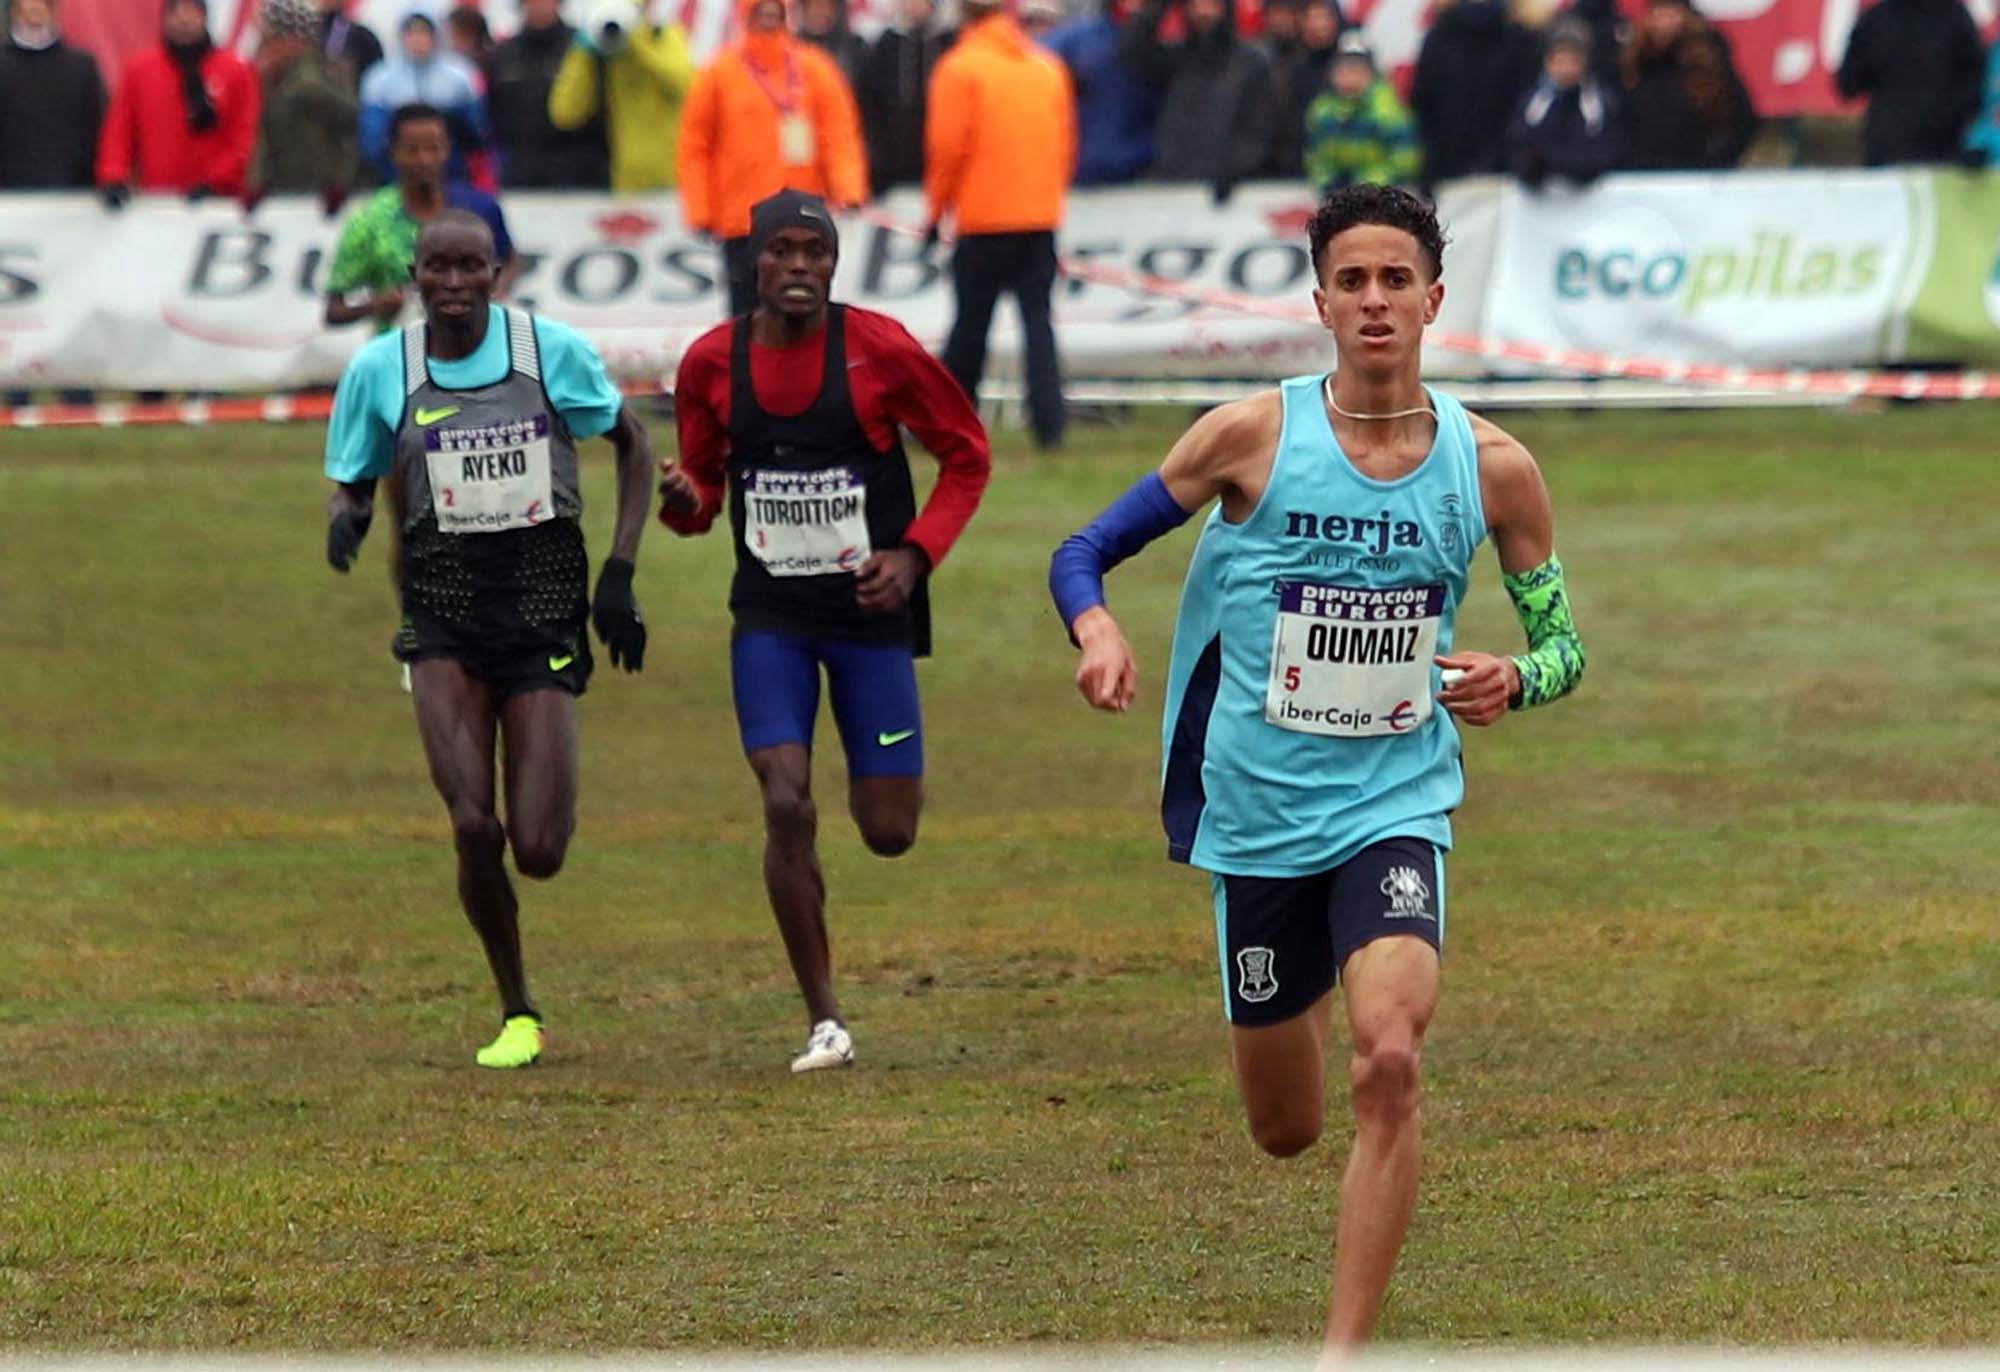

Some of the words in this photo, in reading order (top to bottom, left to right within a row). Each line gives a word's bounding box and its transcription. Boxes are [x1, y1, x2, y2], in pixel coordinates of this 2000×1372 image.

[1553, 228, 1884, 318] ecopilas
[440, 431, 536, 452] BURGOS
[461, 449, 527, 483] AYEKO
[441, 488, 455, 507] 2
[755, 479, 849, 496] BURGOS
[752, 494, 858, 526] TOROITICH
[1285, 509, 1424, 556] nerja
[1303, 550, 1401, 573] ATLETISMO
[1301, 584, 1430, 606] DIPUTACIÓN
[1299, 599, 1427, 620] BURGOS
[1306, 623, 1420, 665] OUMAIZ
[1284, 665, 1302, 692] 5
[1279, 700, 1373, 731] iberCaja
